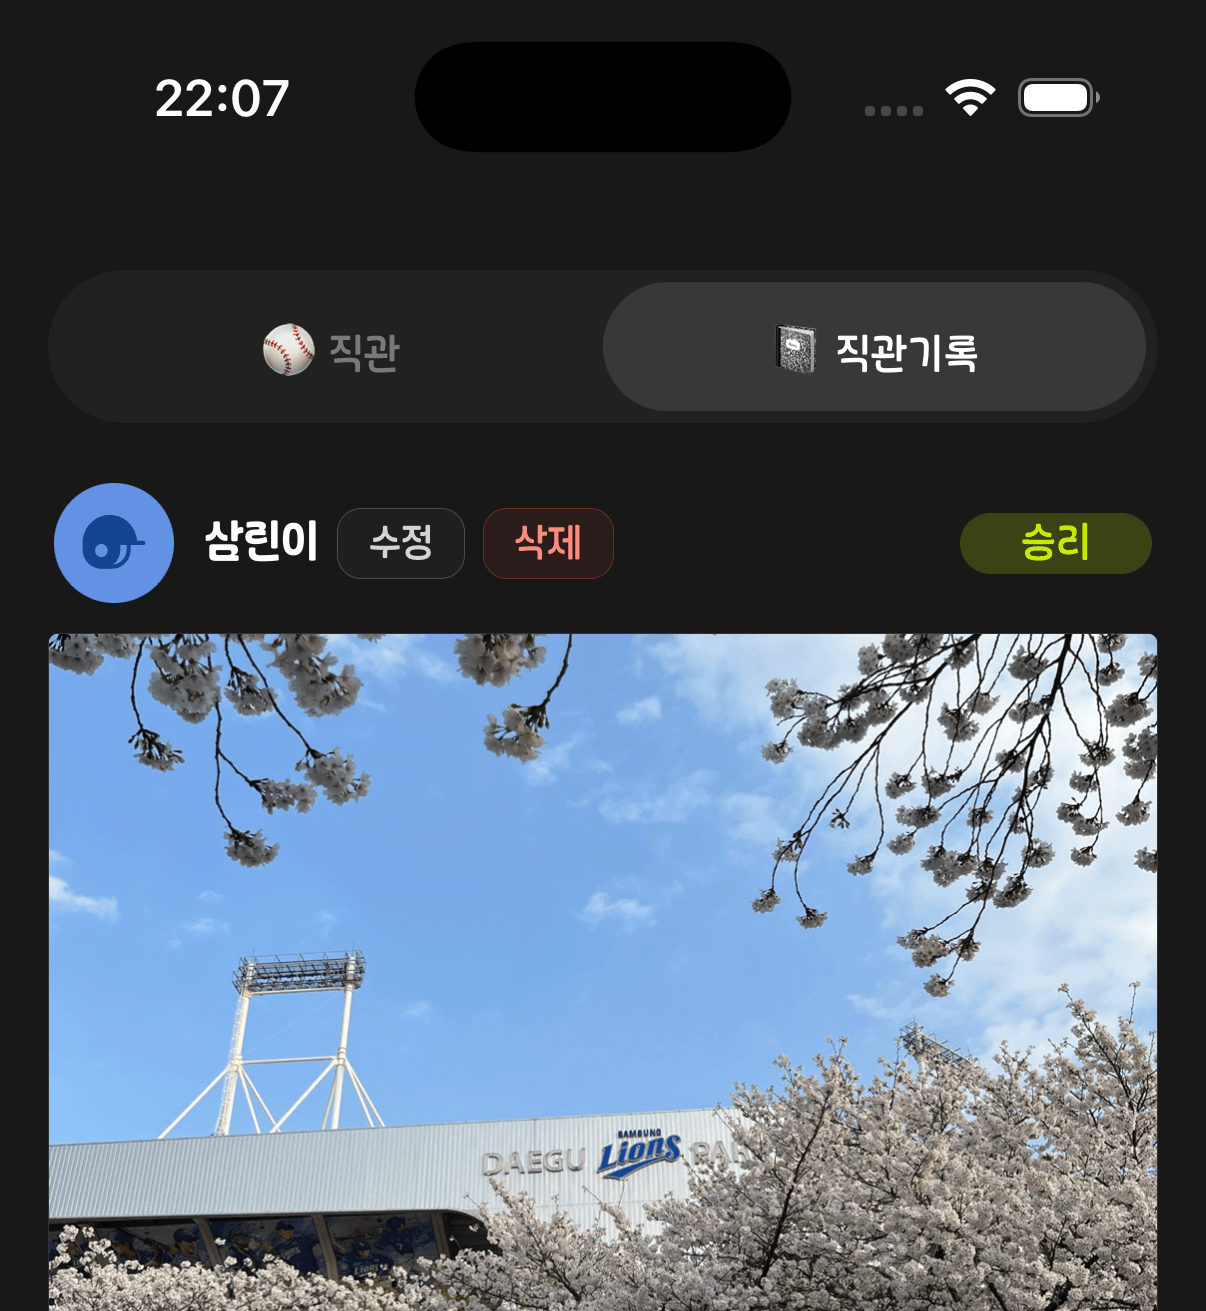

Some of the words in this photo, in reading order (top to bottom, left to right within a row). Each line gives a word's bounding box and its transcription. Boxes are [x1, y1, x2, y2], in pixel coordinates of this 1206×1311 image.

[155, 78, 290, 118] 22:07
[330, 334, 401, 374] 직관
[836, 333, 978, 374] 직관기록
[204, 519, 317, 563] 삼린이
[369, 524, 432, 561] 수정
[514, 524, 581, 561] 삭제
[1021, 522, 1088, 562] 승리
[617, 1127, 662, 1139] SAMSUNG
[692, 1140, 752, 1166] PAR
[482, 1147, 586, 1176] DAEGU
[596, 1134, 682, 1175] Lions
